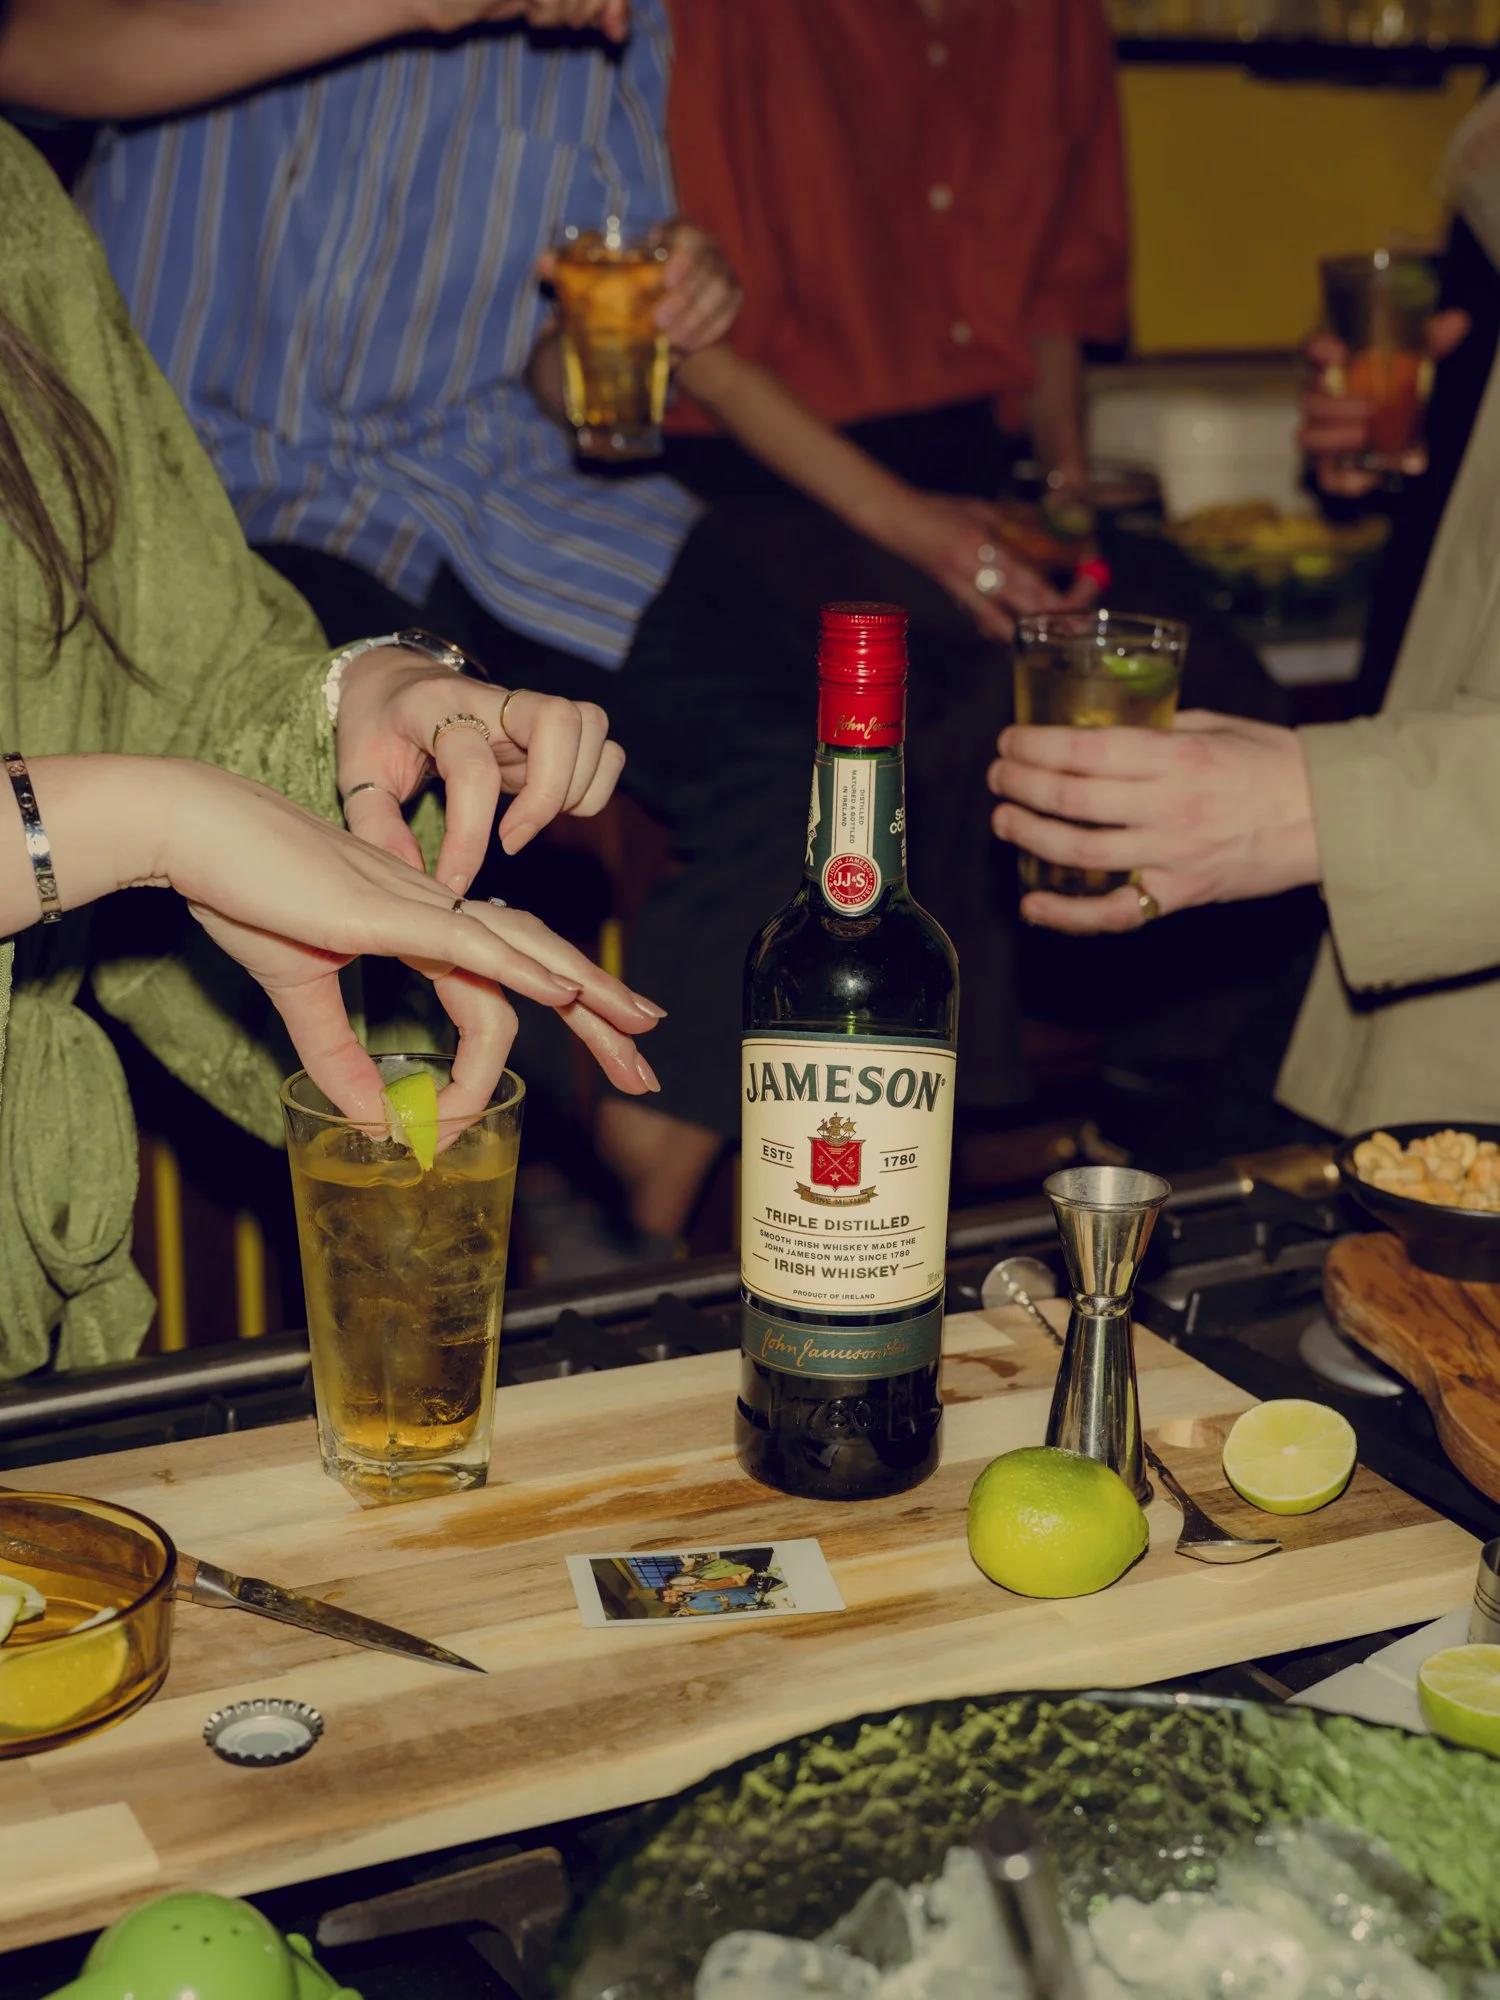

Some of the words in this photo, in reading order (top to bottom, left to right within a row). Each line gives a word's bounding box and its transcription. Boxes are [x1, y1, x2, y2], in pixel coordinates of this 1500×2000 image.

[842, 786, 848, 794] IN
[829, 860, 843, 877] JOHN
[845, 858, 874, 878] JAMESON
[832, 890, 846, 902] SON
[848, 884, 872, 904] LIMITED
[746, 1062, 943, 1112] JAMESON
[883, 1152, 916, 1168] 1780
[766, 1206, 818, 1230] TRIPLE
[824, 1215, 910, 1231] DISTILLED
[760, 1228, 792, 1245] SMOOTH
[794, 1239, 820, 1250] IRISH
[823, 1243, 869, 1251] WHISKEY
[872, 1241, 898, 1250] MADE
[900, 1237, 916, 1246] THE
[764, 1242, 784, 1254] JOHN
[786, 1249, 830, 1261] JAMESON
[832, 1254, 855, 1262] WAY
[858, 1252, 888, 1262] SINCE
[890, 1249, 910, 1258] 1780
[774, 1258, 816, 1276] IRISH
[821, 1264, 900, 1279] WHISKEY
[793, 1289, 827, 1300] PRODUCT
[829, 1292, 840, 1300] OF
[762, 1328, 797, 1358] John
[796, 1338, 881, 1367] Jameson
